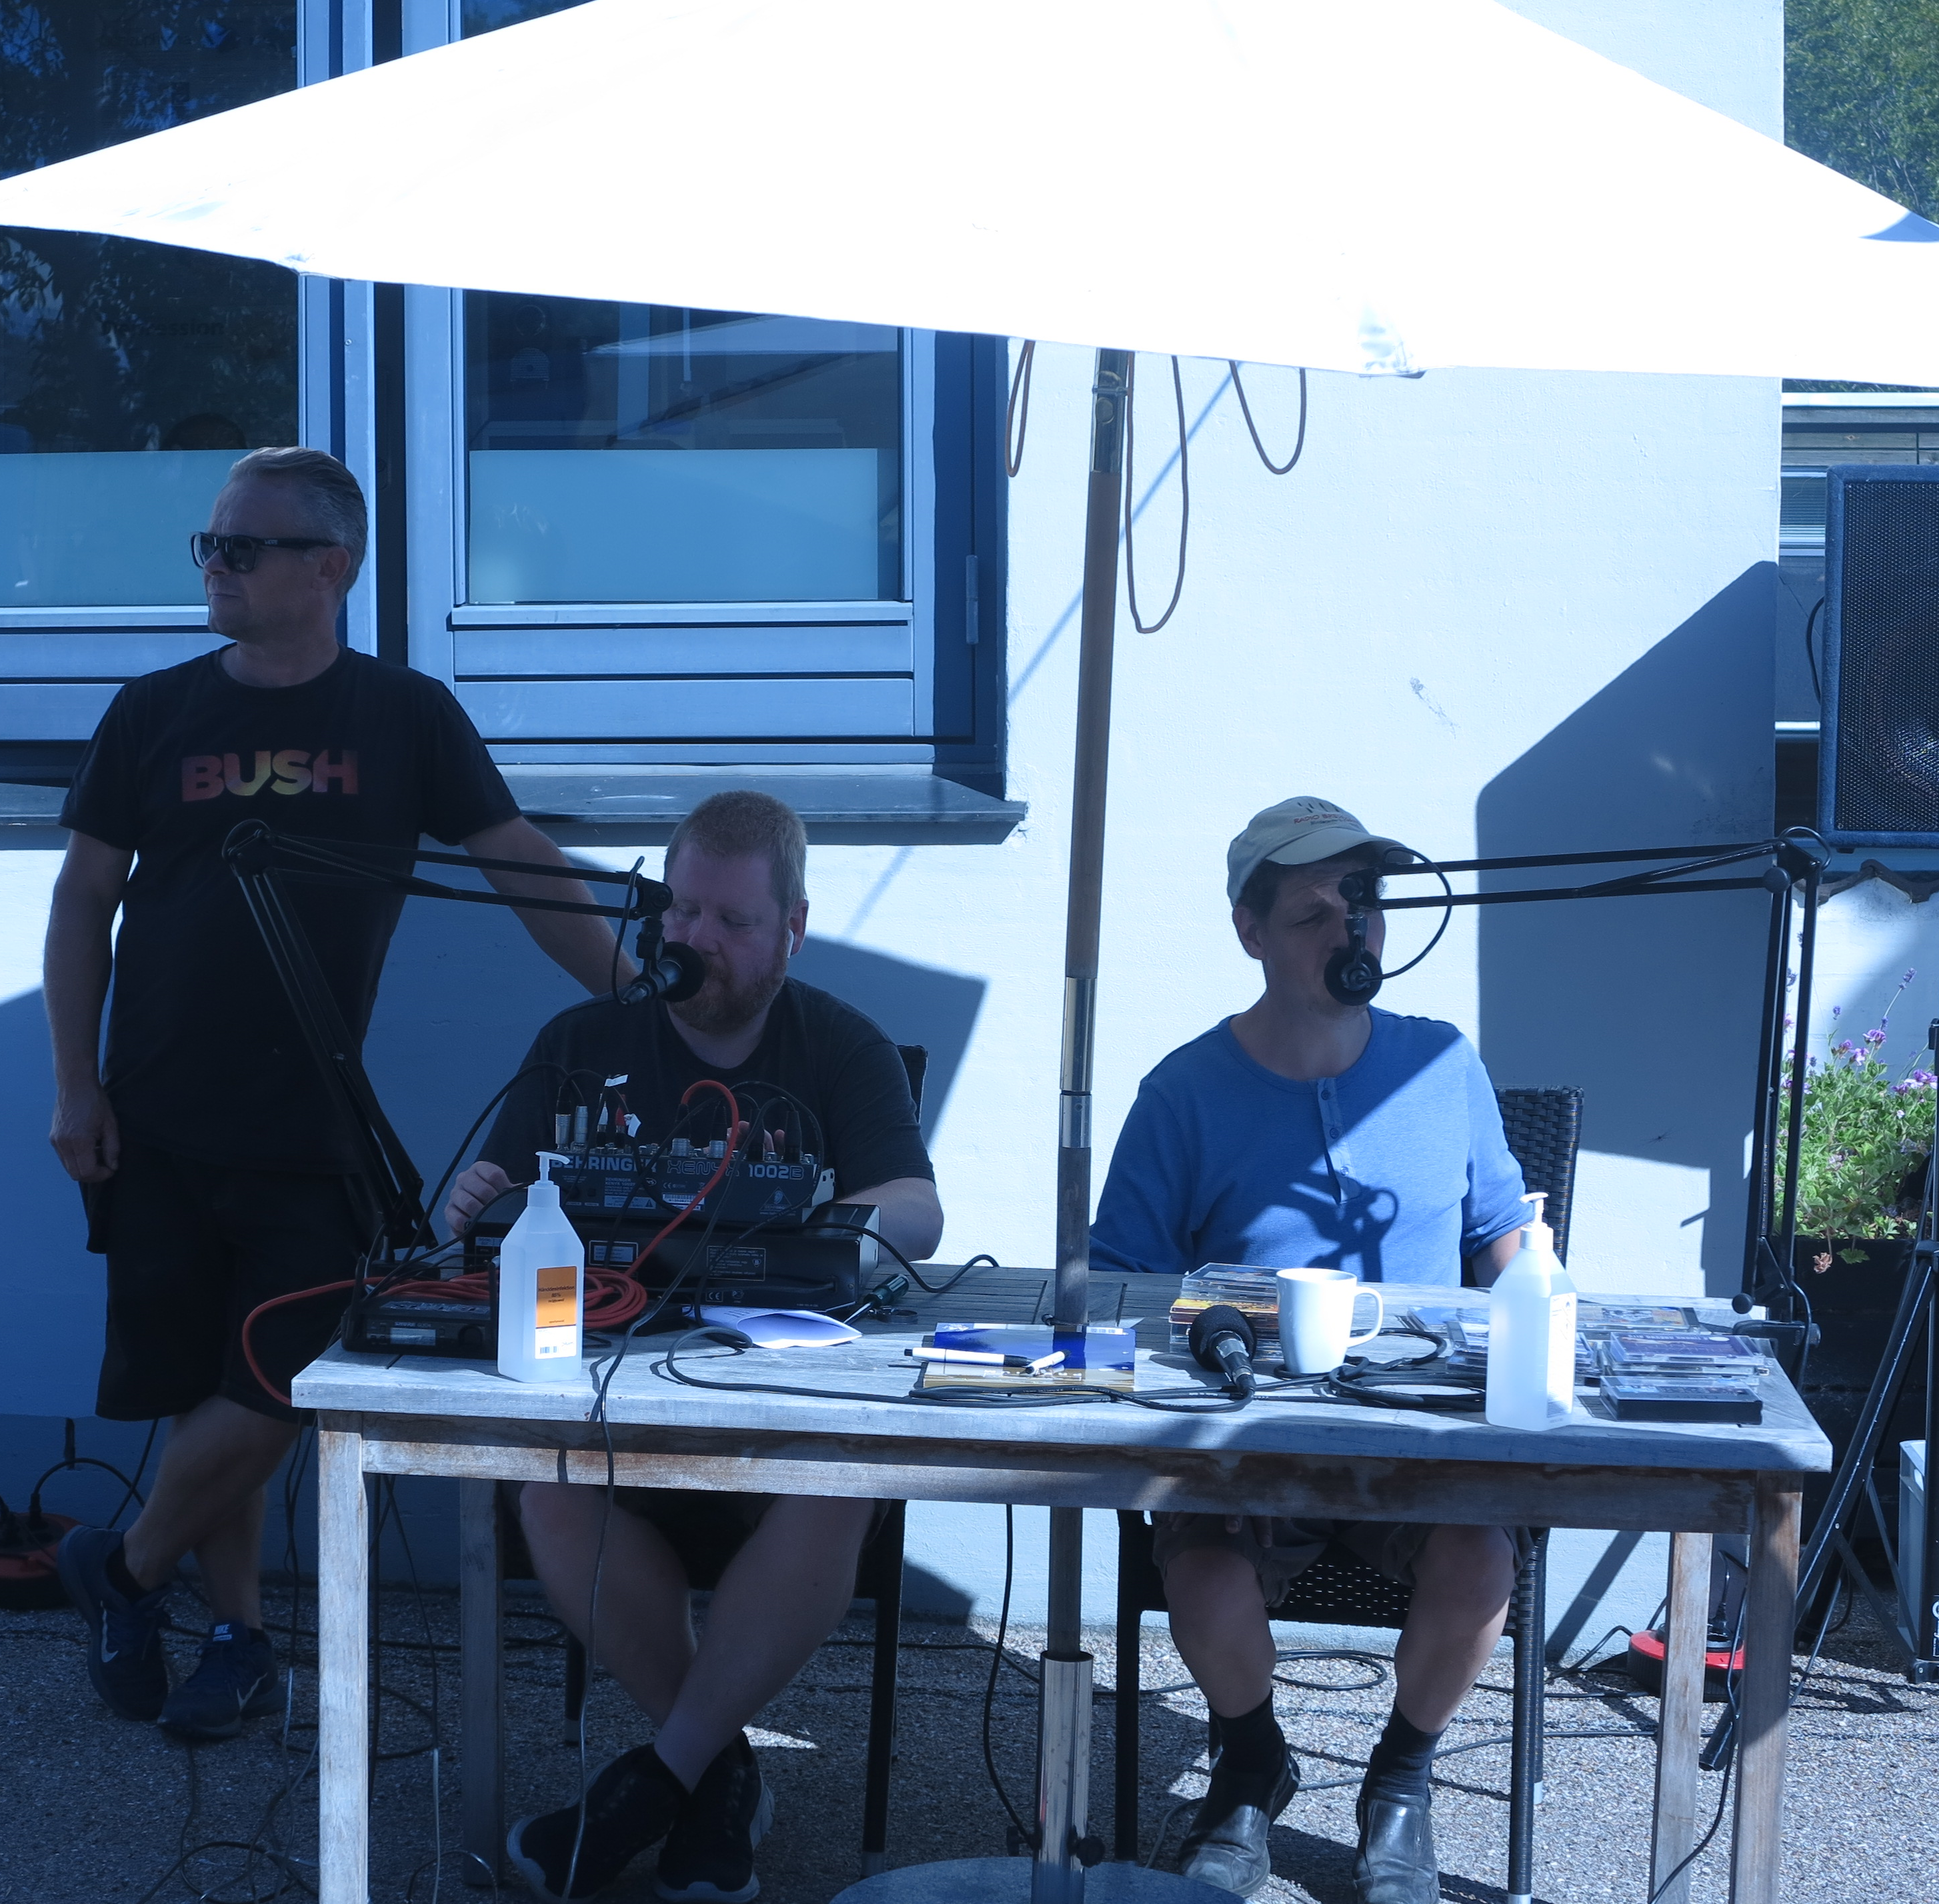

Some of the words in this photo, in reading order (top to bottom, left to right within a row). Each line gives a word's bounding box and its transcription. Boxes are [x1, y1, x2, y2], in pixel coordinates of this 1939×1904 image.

[182, 749, 359, 802] BUSH
[1293, 814, 1320, 824] RADIO
[748, 1163, 804, 1180] 1002B
